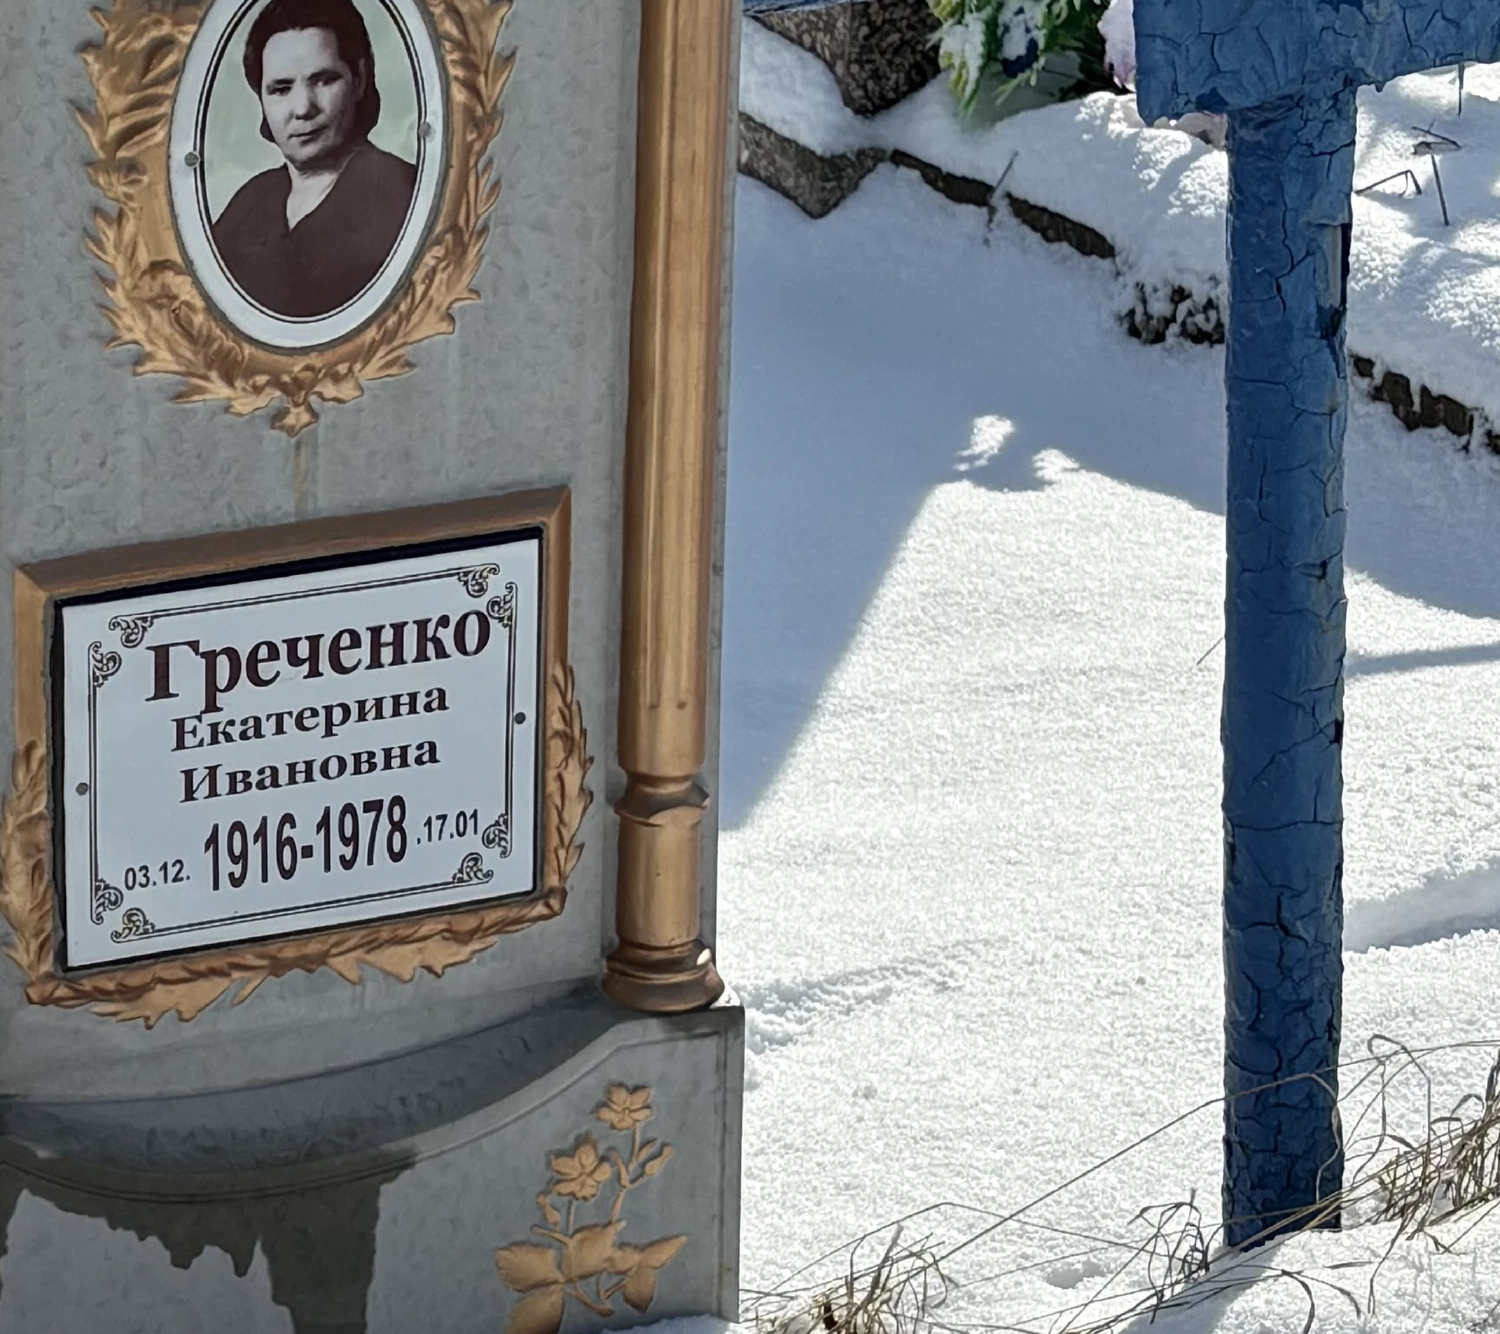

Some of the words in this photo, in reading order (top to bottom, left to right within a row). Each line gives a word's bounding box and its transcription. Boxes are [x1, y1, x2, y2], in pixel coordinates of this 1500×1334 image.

[145, 608, 492, 714] Греченко
[171, 687, 450, 753] Екатерина
[179, 739, 442, 804] Ивановна
[123, 858, 191, 892] 03.12.
[203, 794, 408, 892] 1916-1978
